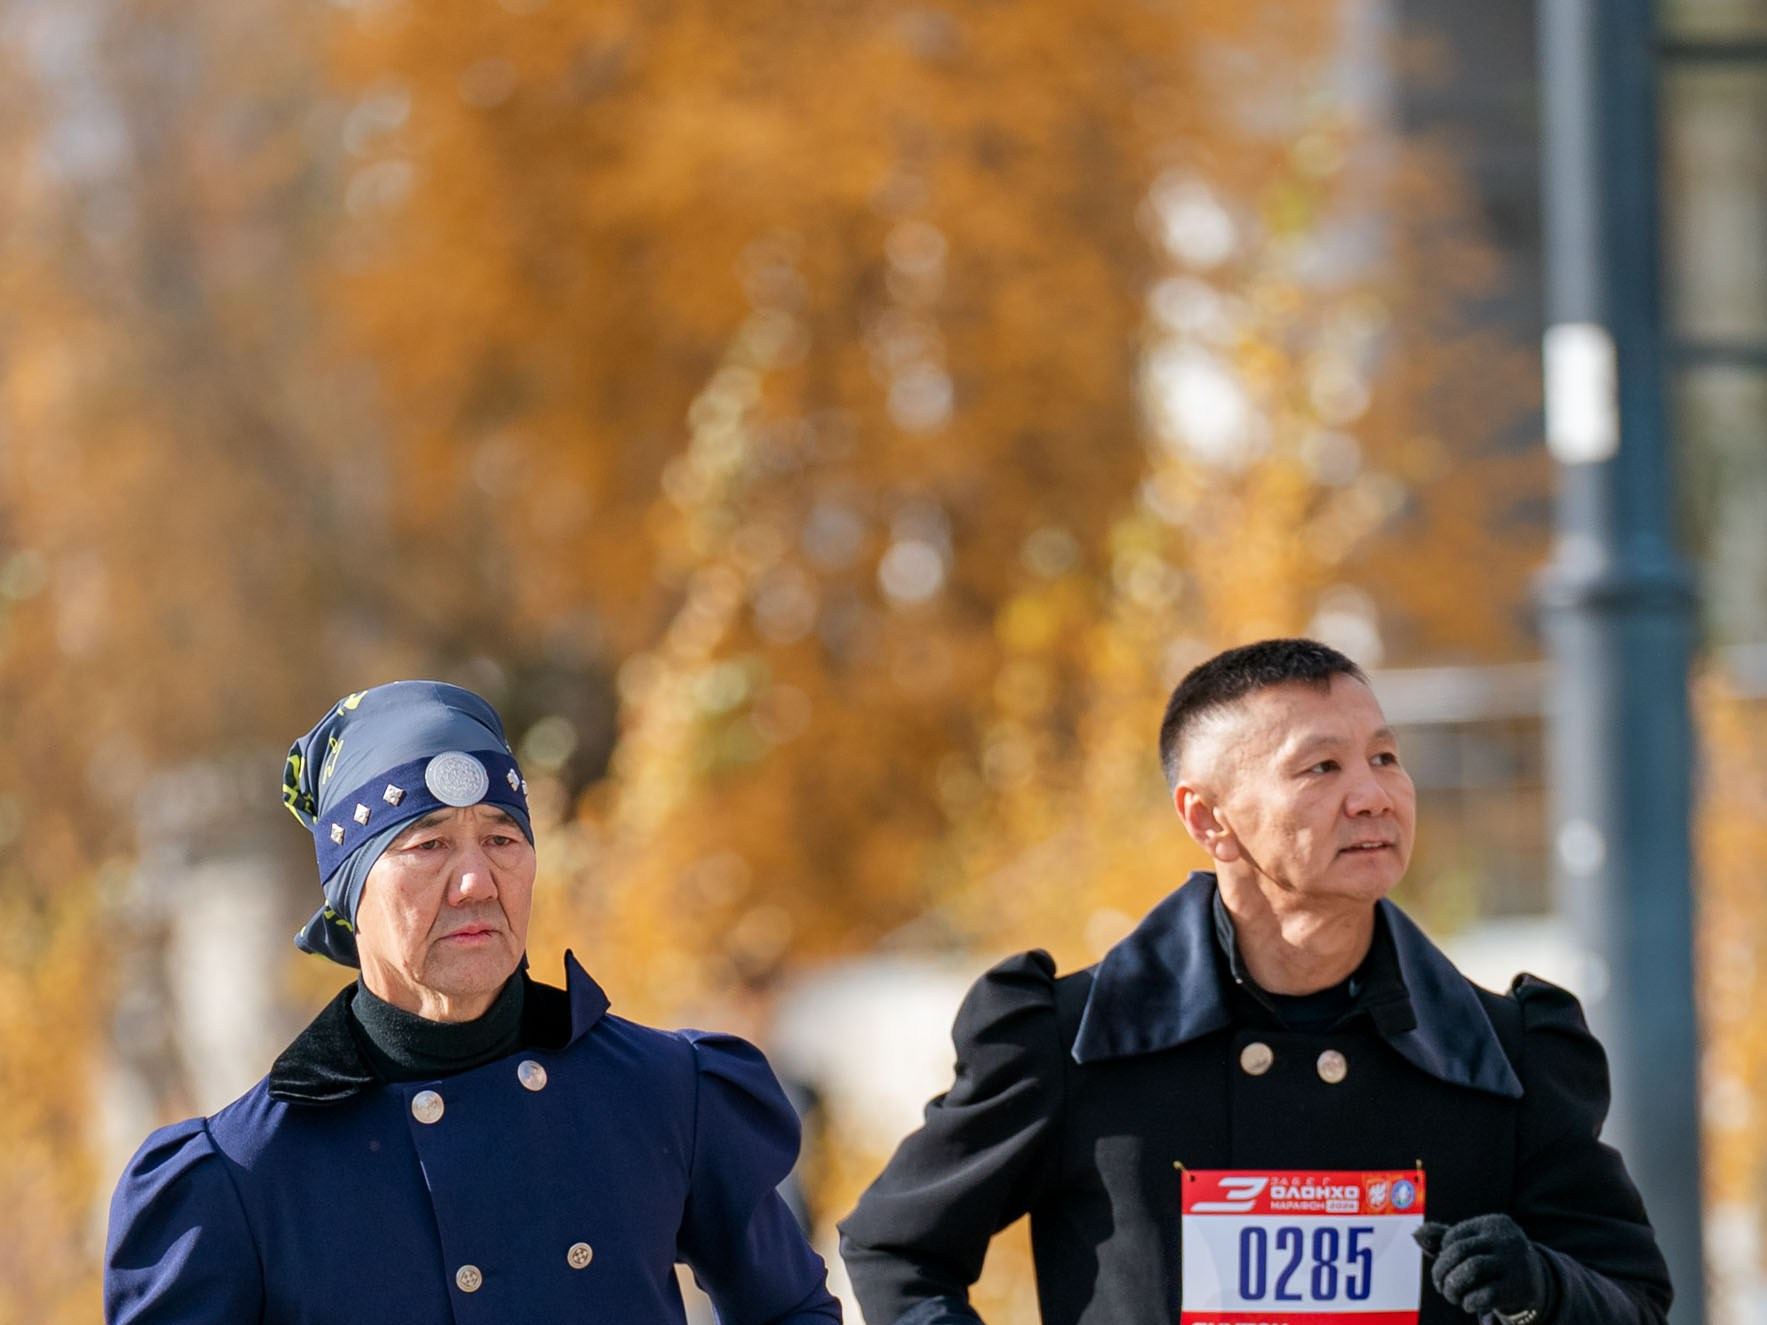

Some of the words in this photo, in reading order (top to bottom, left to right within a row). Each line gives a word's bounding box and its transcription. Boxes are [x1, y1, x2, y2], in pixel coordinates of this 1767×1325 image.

[1270, 1185, 1360, 1200] ОЛОНХО
[1270, 1201, 1325, 1210] МАРАФОН
[1239, 1226, 1375, 1301] 0285
